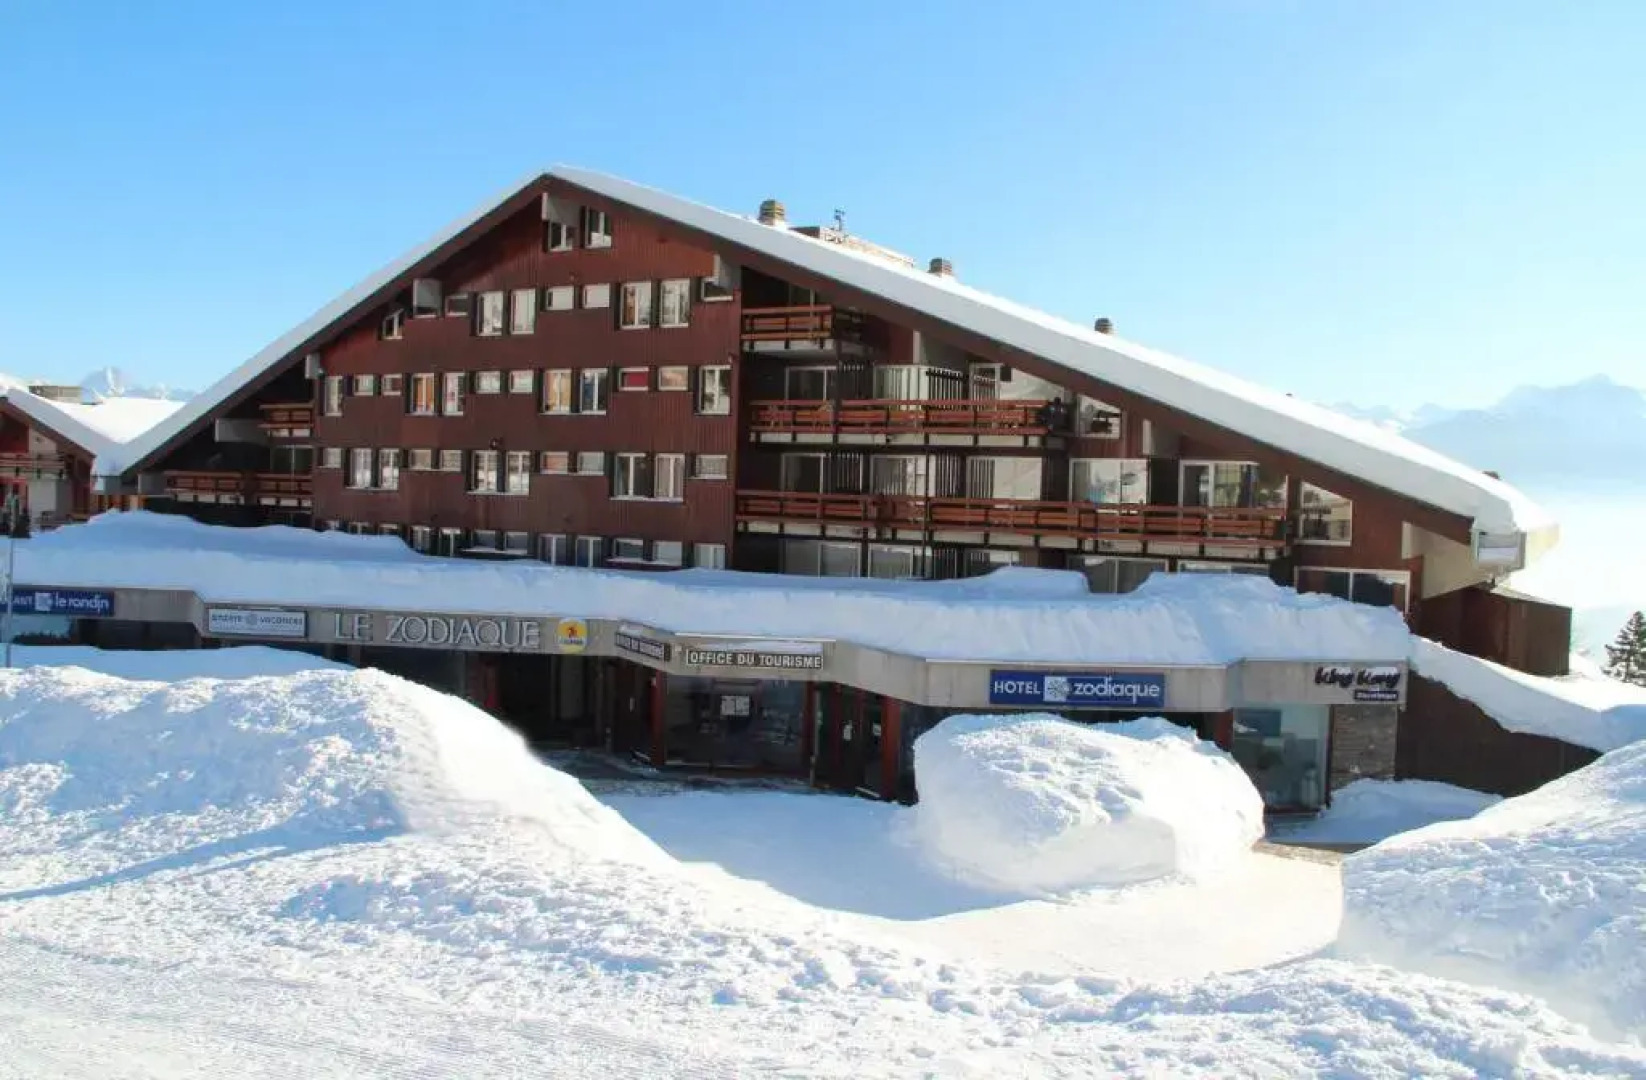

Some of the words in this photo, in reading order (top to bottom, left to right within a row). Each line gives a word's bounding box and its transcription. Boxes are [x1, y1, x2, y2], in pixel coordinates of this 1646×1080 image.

[334, 612, 374, 641] LE
[385, 614, 541, 648] ZODIAQUE
[690, 651, 733, 665] OFFICE
[737, 653, 755, 666] DU
[760, 654, 822, 668] TOURISME
[994, 680, 1041, 694] HOTEL
[1073, 674, 1160, 704] zodiaque
